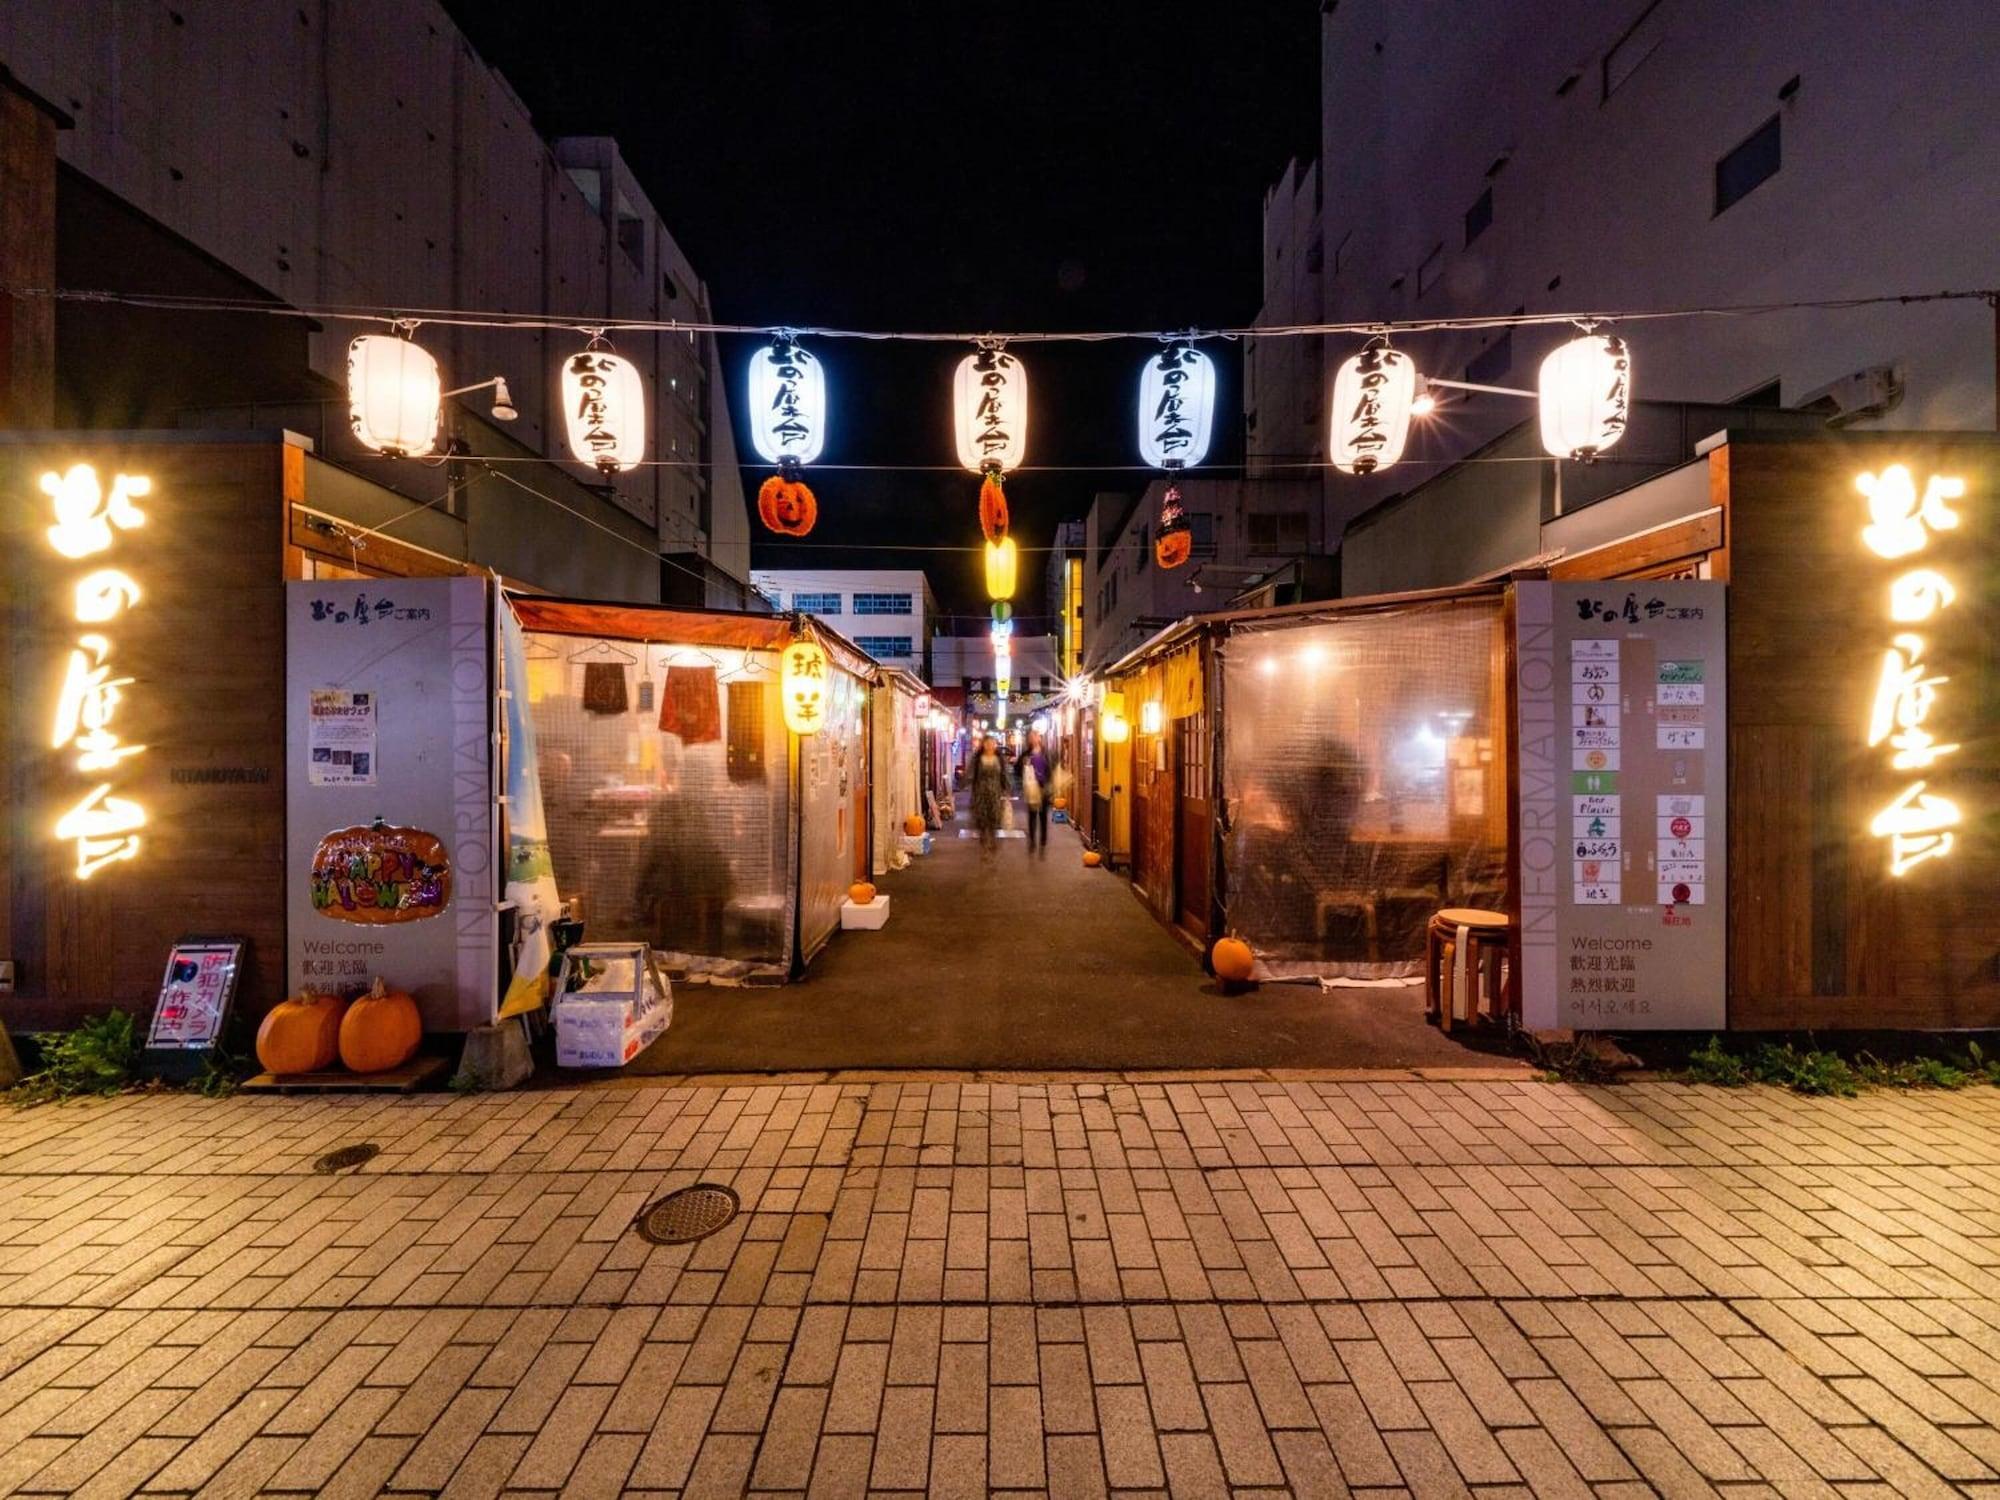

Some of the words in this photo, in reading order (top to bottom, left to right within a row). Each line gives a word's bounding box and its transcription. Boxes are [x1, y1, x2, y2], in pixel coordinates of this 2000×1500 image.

[570, 354, 617, 452] 北の屋台
[768, 345, 812, 446] 北の屋台
[972, 352, 1015, 456] 北の屋台
[1154, 348, 1201, 454] 北の屋台
[1348, 350, 1402, 454] 北の屋台
[38, 462, 153, 881] 北の屋台
[1853, 463, 1966, 878] 北の屋台
[453, 622, 491, 950] INFORMATION
[1519, 623, 1557, 946] INFORMATION
[187, 954, 226, 1036] 防犯カメラ
[303, 940, 385, 955] Welcome
[1571, 936, 1653, 951] Welcome
